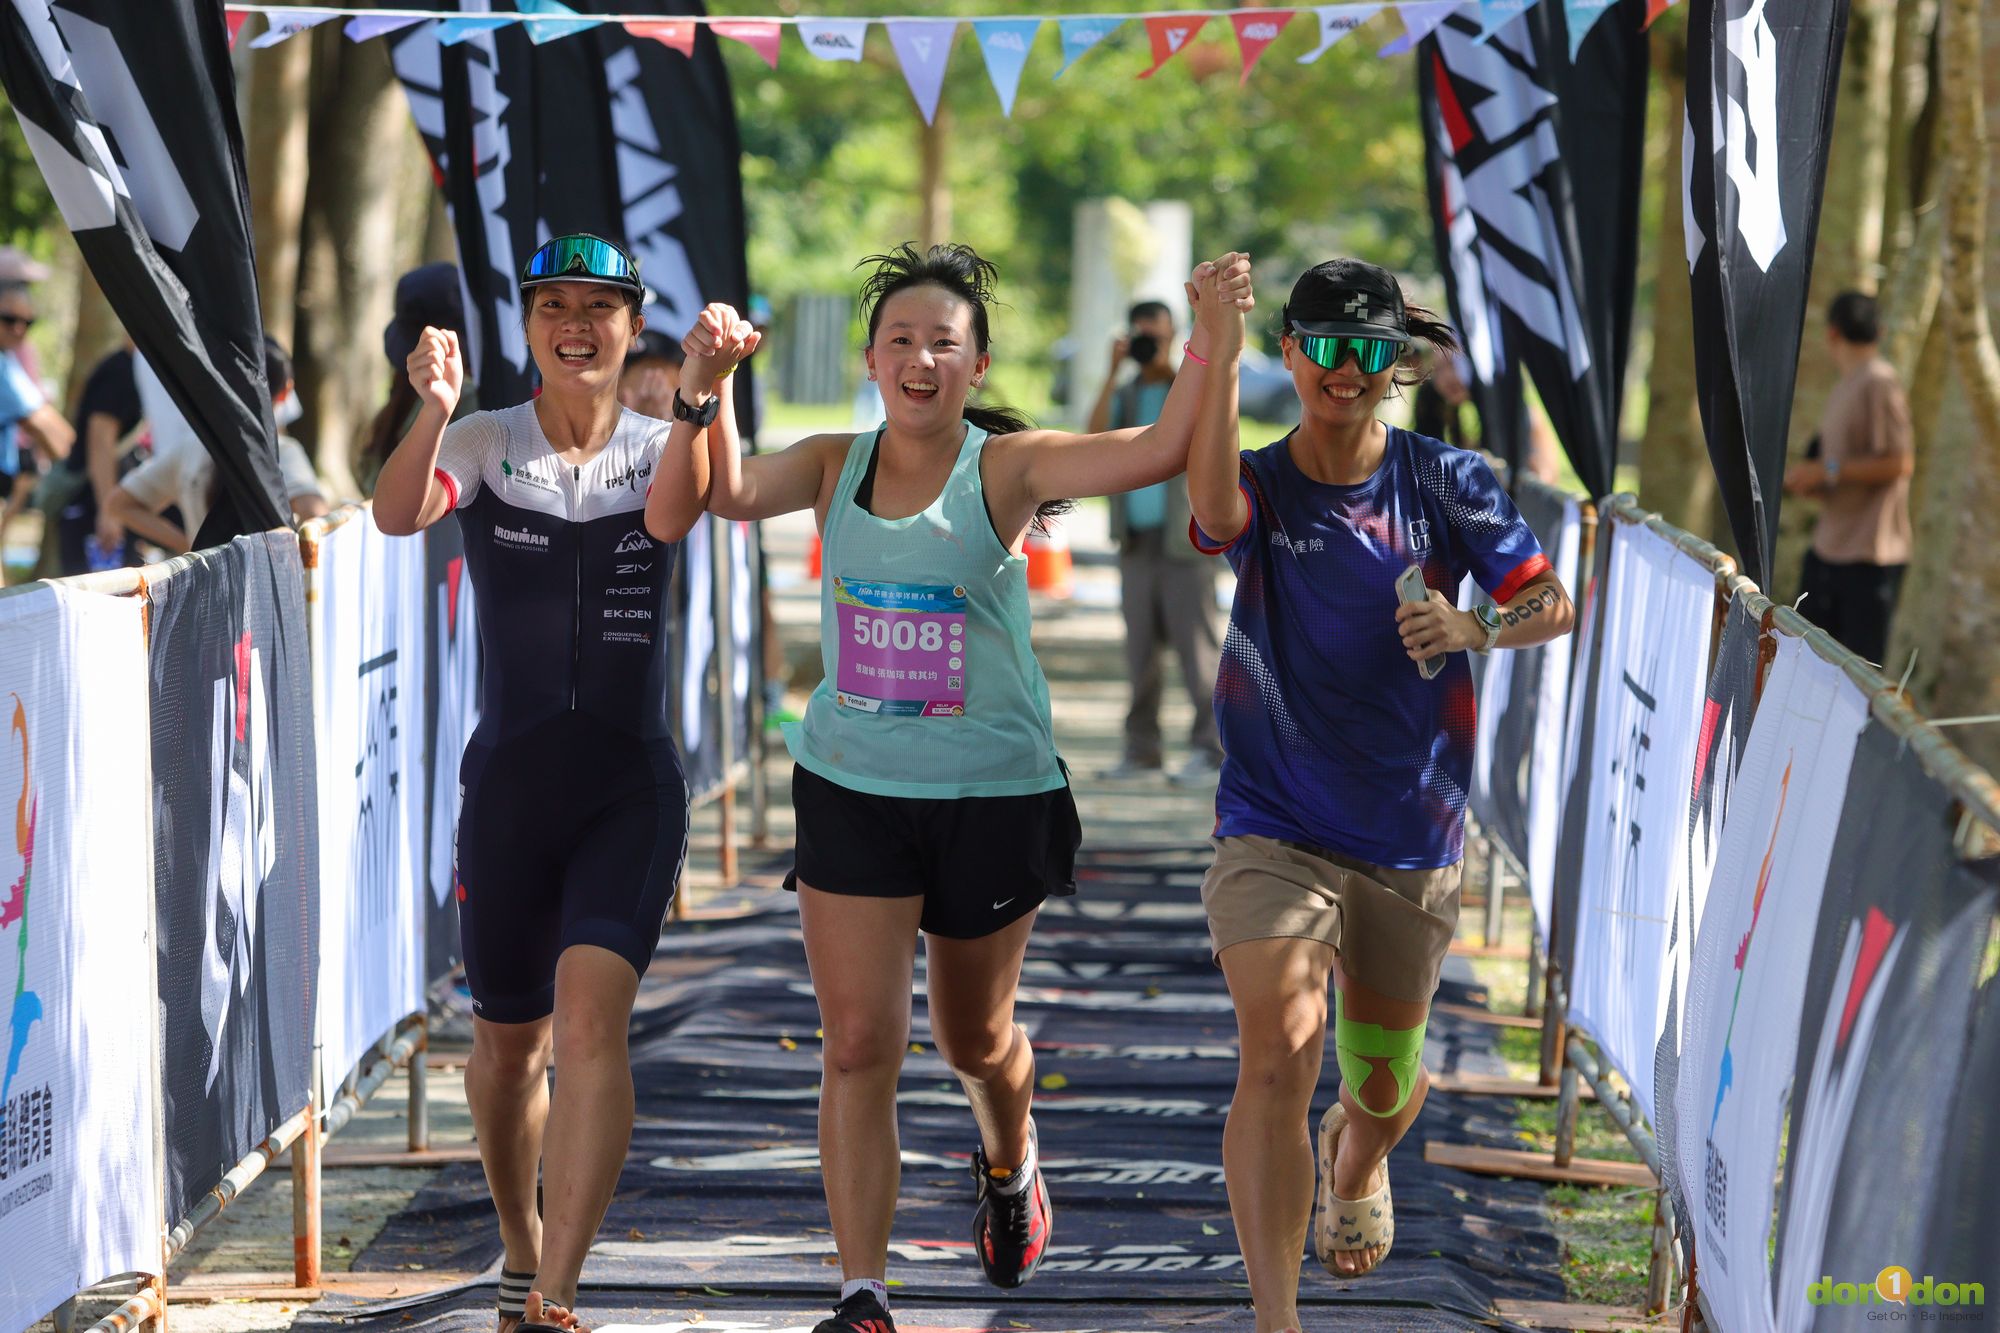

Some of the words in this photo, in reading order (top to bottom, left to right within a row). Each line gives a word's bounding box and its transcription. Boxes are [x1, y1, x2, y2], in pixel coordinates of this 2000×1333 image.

[605, 475, 625, 490] TPE
[494, 525, 549, 546] IRONMAN
[614, 538, 654, 553] LAVA
[854, 614, 943, 652] 5008
[847, 696, 868, 707] Female
